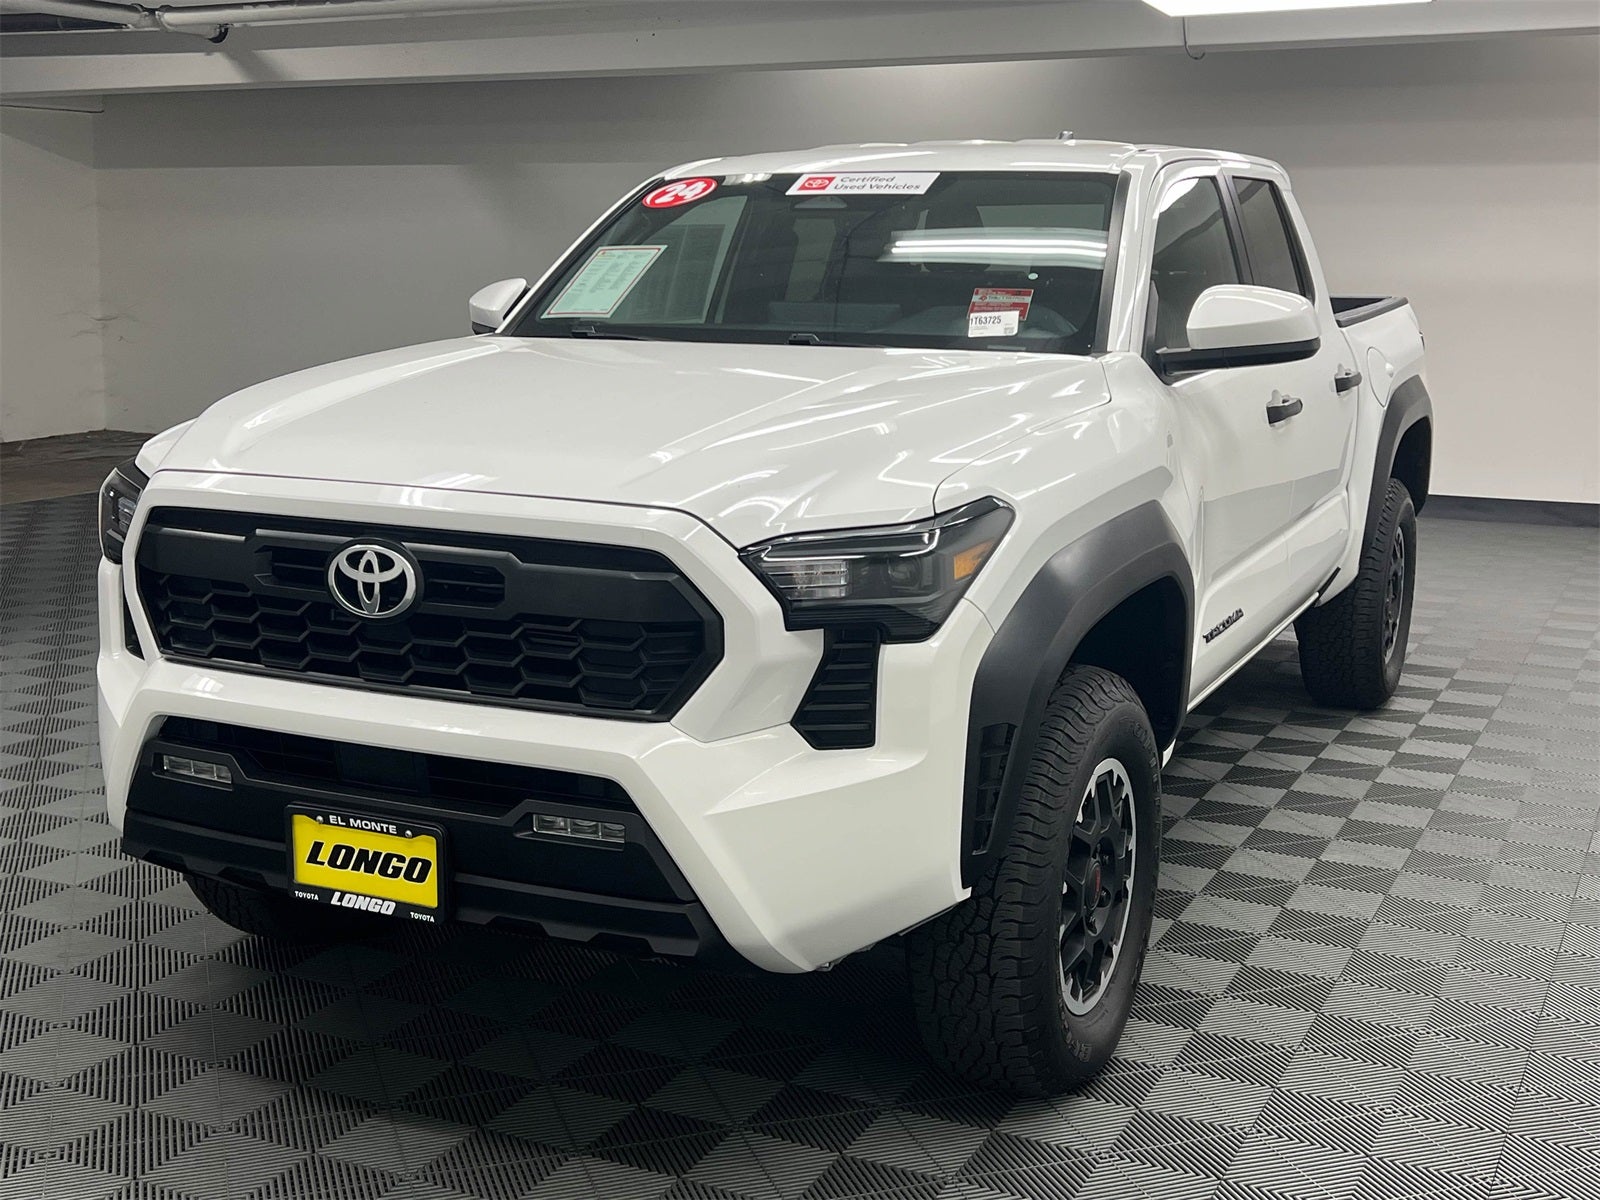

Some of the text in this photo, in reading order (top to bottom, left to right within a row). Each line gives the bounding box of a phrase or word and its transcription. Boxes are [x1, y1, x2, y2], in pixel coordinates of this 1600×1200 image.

[655, 180, 707, 203] 24
[329, 815, 397, 834] EL MONTE
[305, 840, 433, 884] LONGO
[294, 890, 319, 901] TOYOTA
[330, 892, 396, 916] LONGO
[410, 911, 435, 923] TOYOTA
